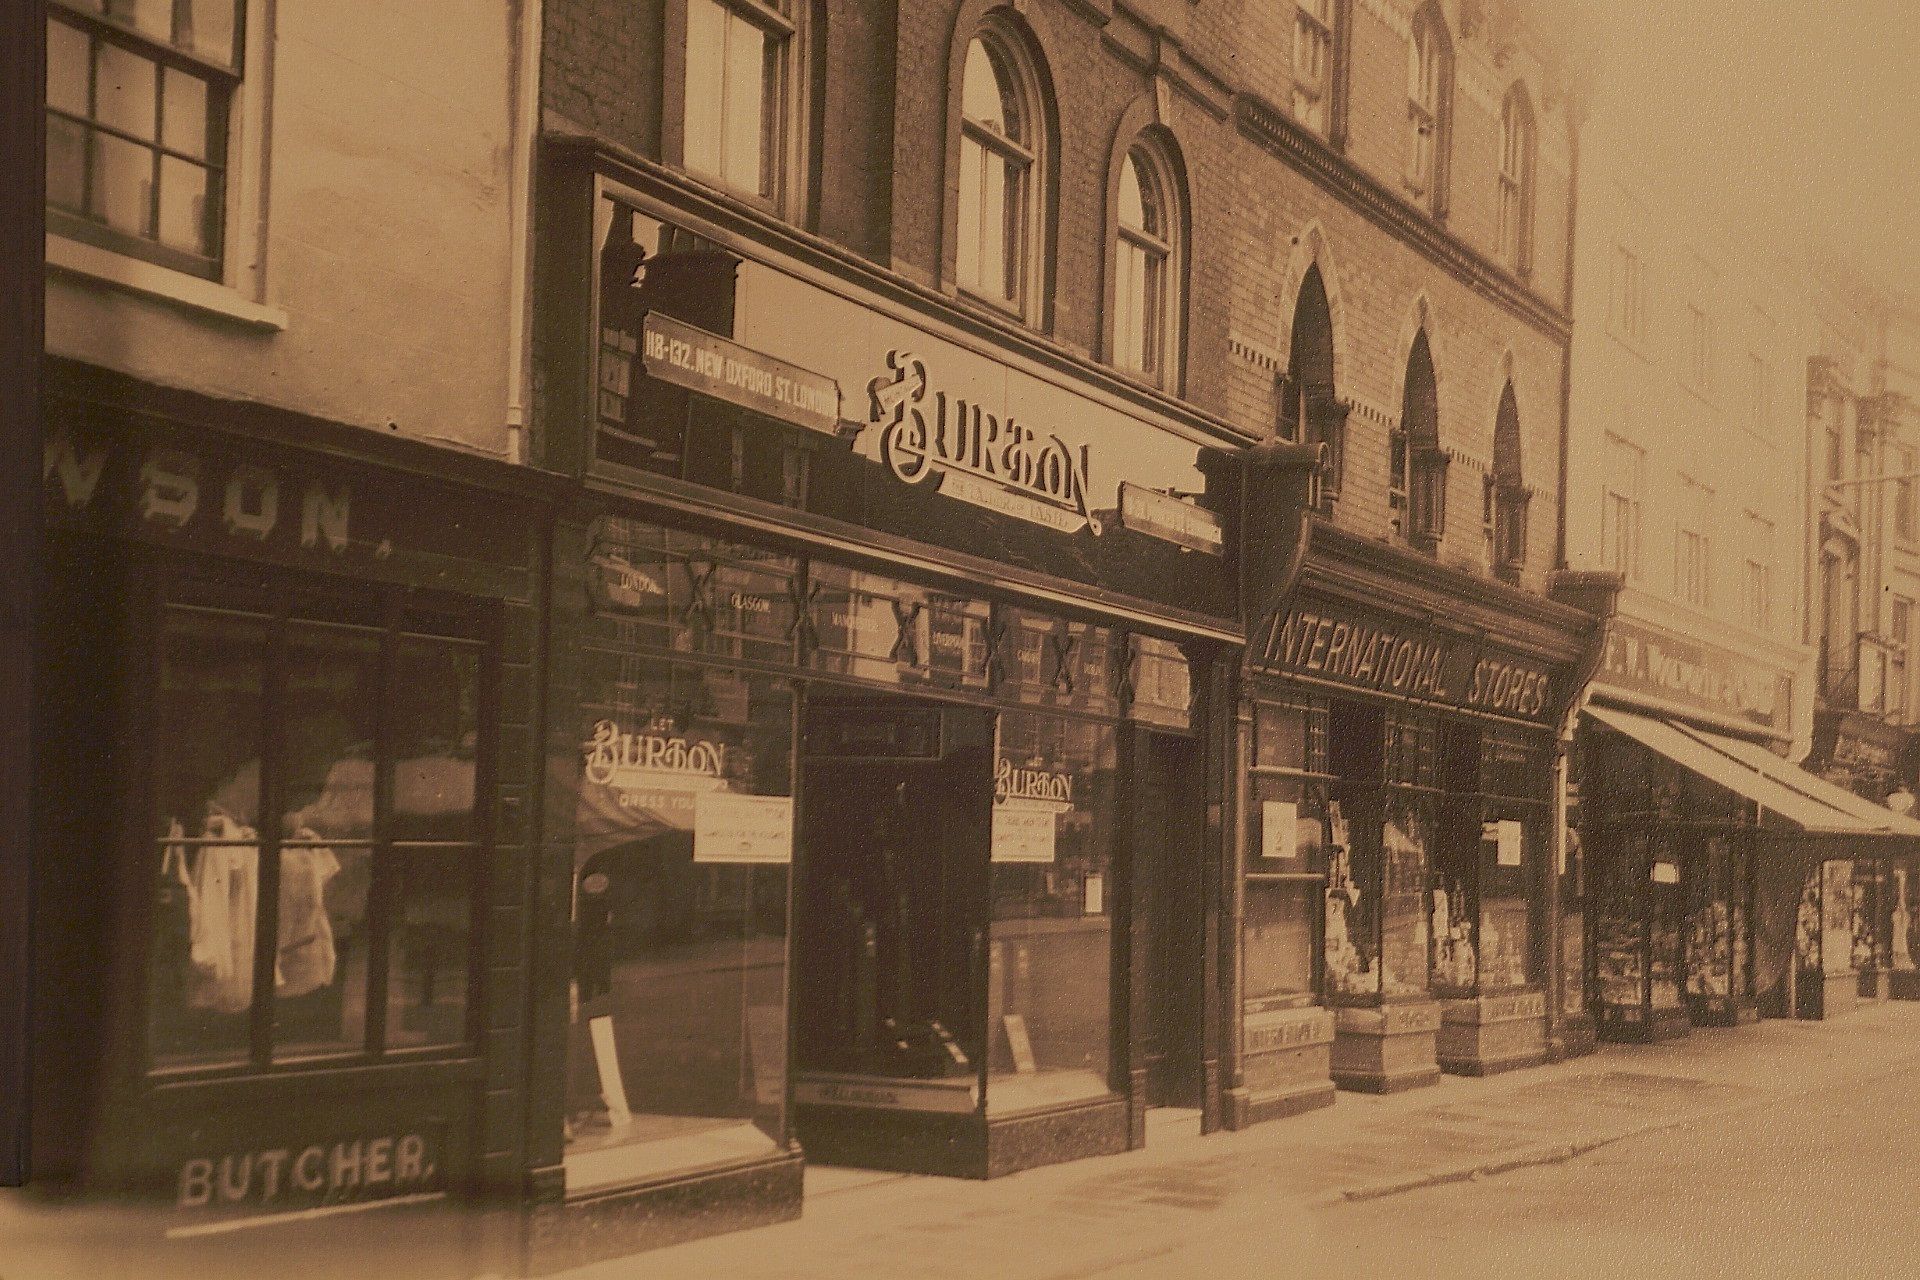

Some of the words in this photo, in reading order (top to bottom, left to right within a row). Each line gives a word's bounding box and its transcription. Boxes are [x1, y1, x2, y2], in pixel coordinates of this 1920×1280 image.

[696, 348, 724, 380] NEW
[726, 359, 773, 398] OXFORD
[793, 382, 837, 420] LOND
[866, 348, 1102, 536] BURTON
[1263, 609, 1449, 698] INTERNATIONAL
[1467, 657, 1548, 717] STORES
[584, 718, 726, 785] BURTON
[994, 757, 1073, 805] BURTON
